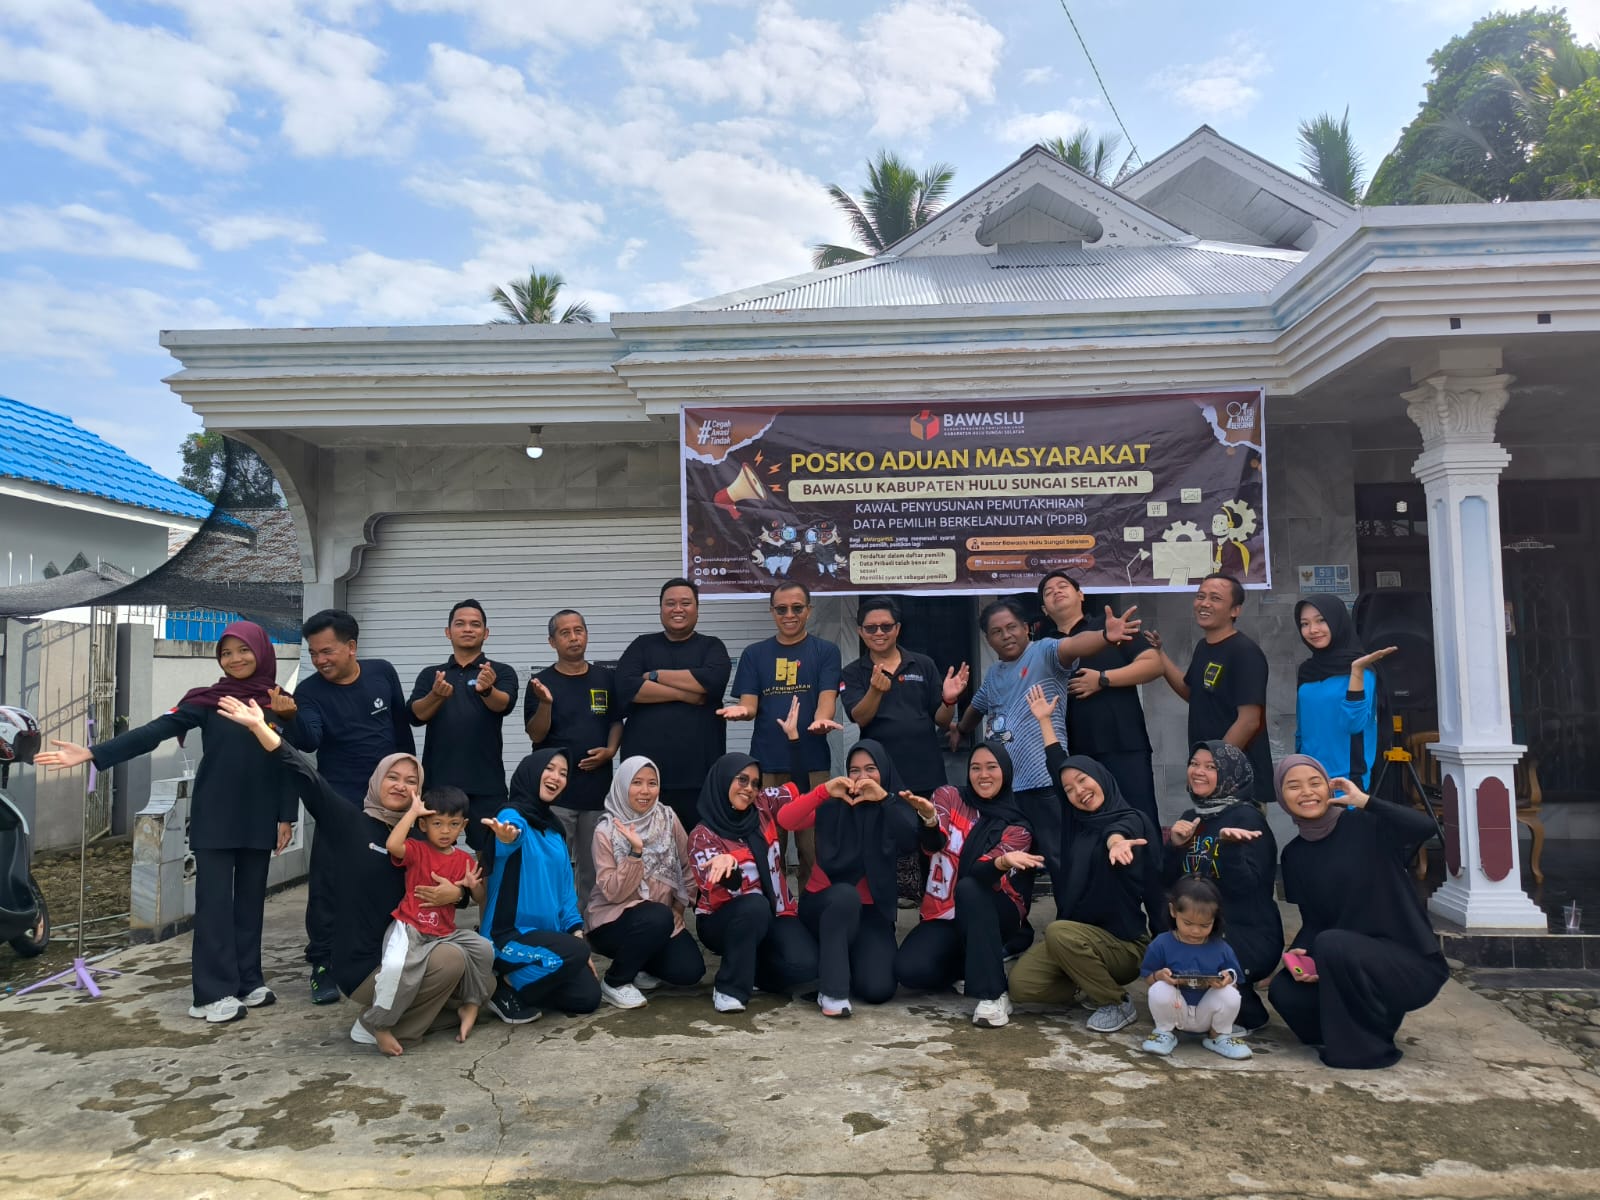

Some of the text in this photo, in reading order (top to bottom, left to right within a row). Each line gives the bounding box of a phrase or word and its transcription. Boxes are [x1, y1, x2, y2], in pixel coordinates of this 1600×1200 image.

[943, 412, 1024, 427] BAWASLU
[791, 444, 1151, 473] POSKO ADUAN MASYARAKAT
[803, 475, 1138, 496] BAWASLU KABUPATEN HULU SUNGAI SELATAN
[855, 498, 1084, 514] KAWAL PENYUSUNAN PEMUTAKHIRAN
[853, 514, 1087, 530] DATA PEMILIH BERKELANJUTAN (PDPB)
